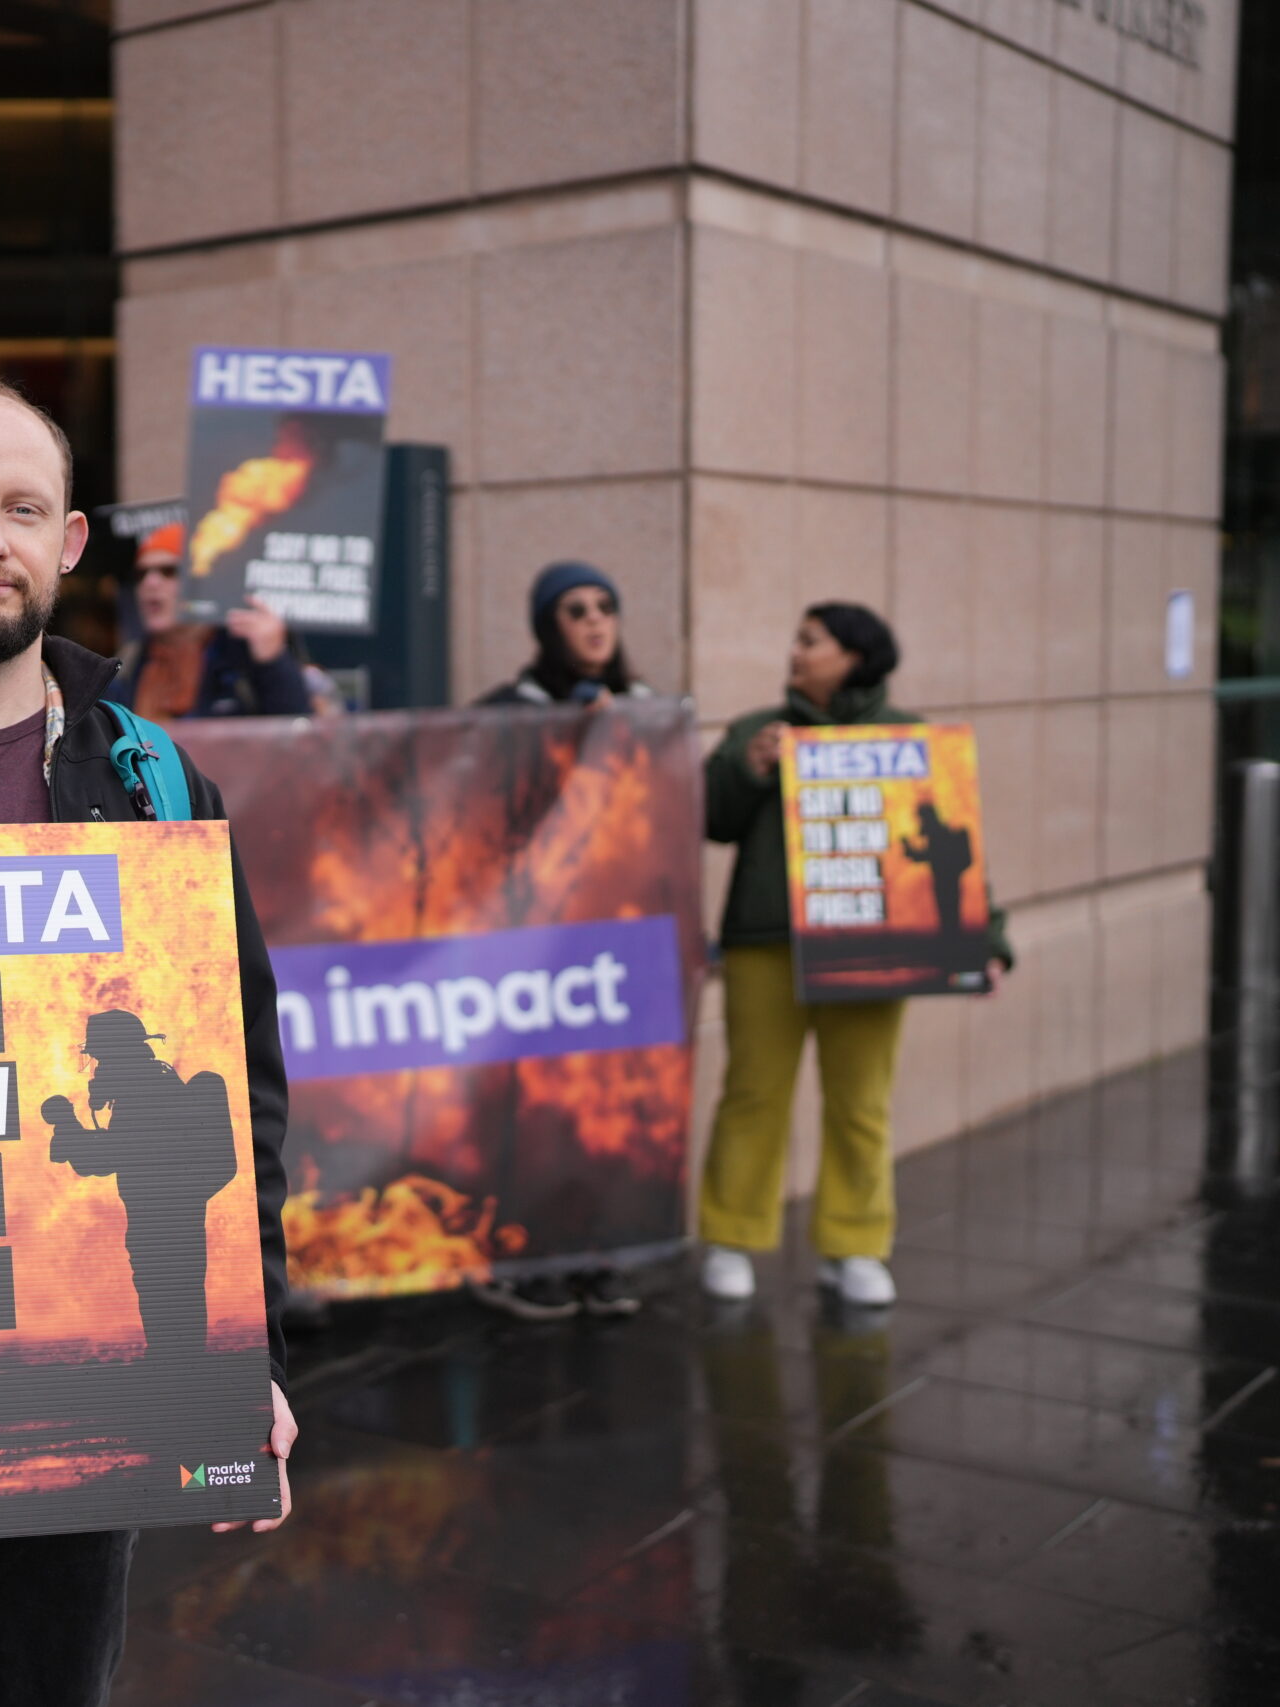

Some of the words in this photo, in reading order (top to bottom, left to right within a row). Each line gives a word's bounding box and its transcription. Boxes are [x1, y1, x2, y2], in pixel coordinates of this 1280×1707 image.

[198, 353, 384, 406] HESTA
[798, 741, 927, 780] HESTA
[799, 785, 844, 818] SAY
[848, 784, 883, 817] NO
[801, 821, 832, 852] TO
[836, 820, 888, 852] NEW
[804, 856, 883, 889] FOSSIL
[276, 990, 316, 1053] n
[325, 951, 630, 1053] impact
[207, 1461, 255, 1475] market
[208, 1473, 251, 1486] forces
